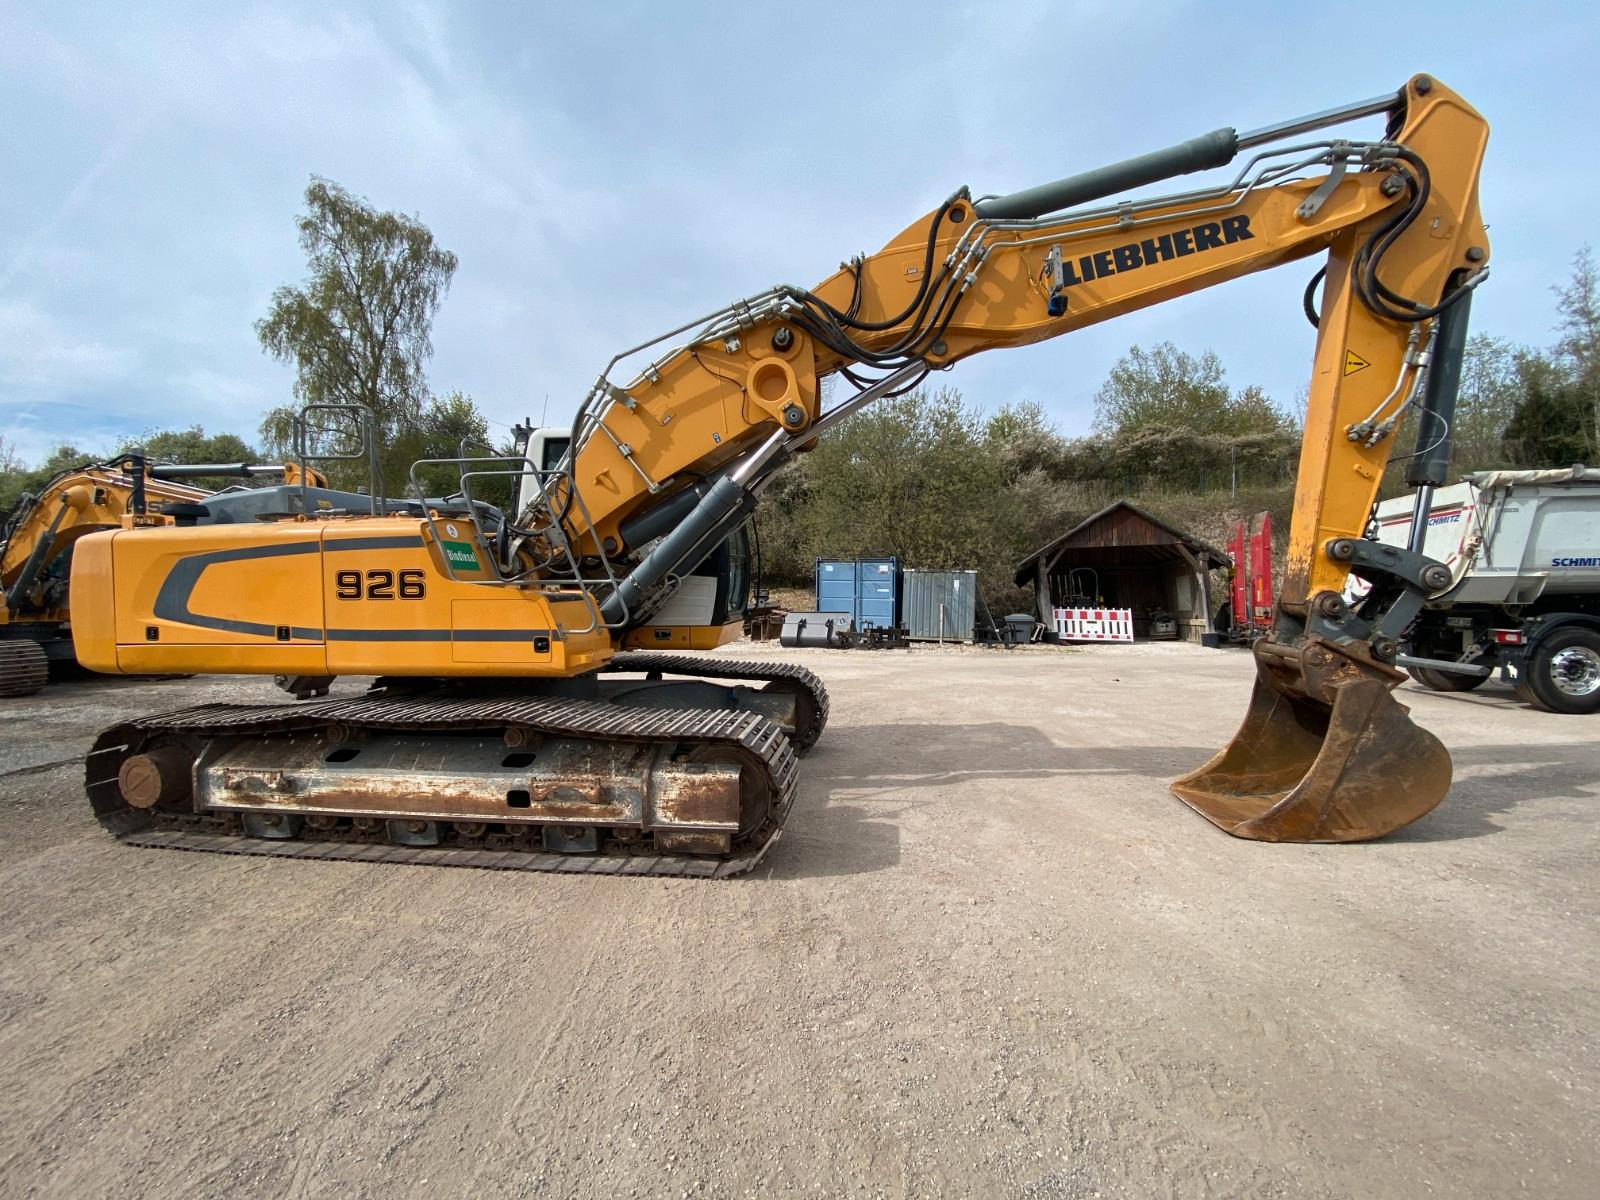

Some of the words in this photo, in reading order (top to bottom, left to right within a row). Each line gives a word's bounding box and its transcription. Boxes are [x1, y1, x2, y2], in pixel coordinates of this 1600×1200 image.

[1062, 214, 1255, 288] LIEBHERR
[1427, 514, 1461, 526] CHMITZ
[336, 569, 426, 600] 926
